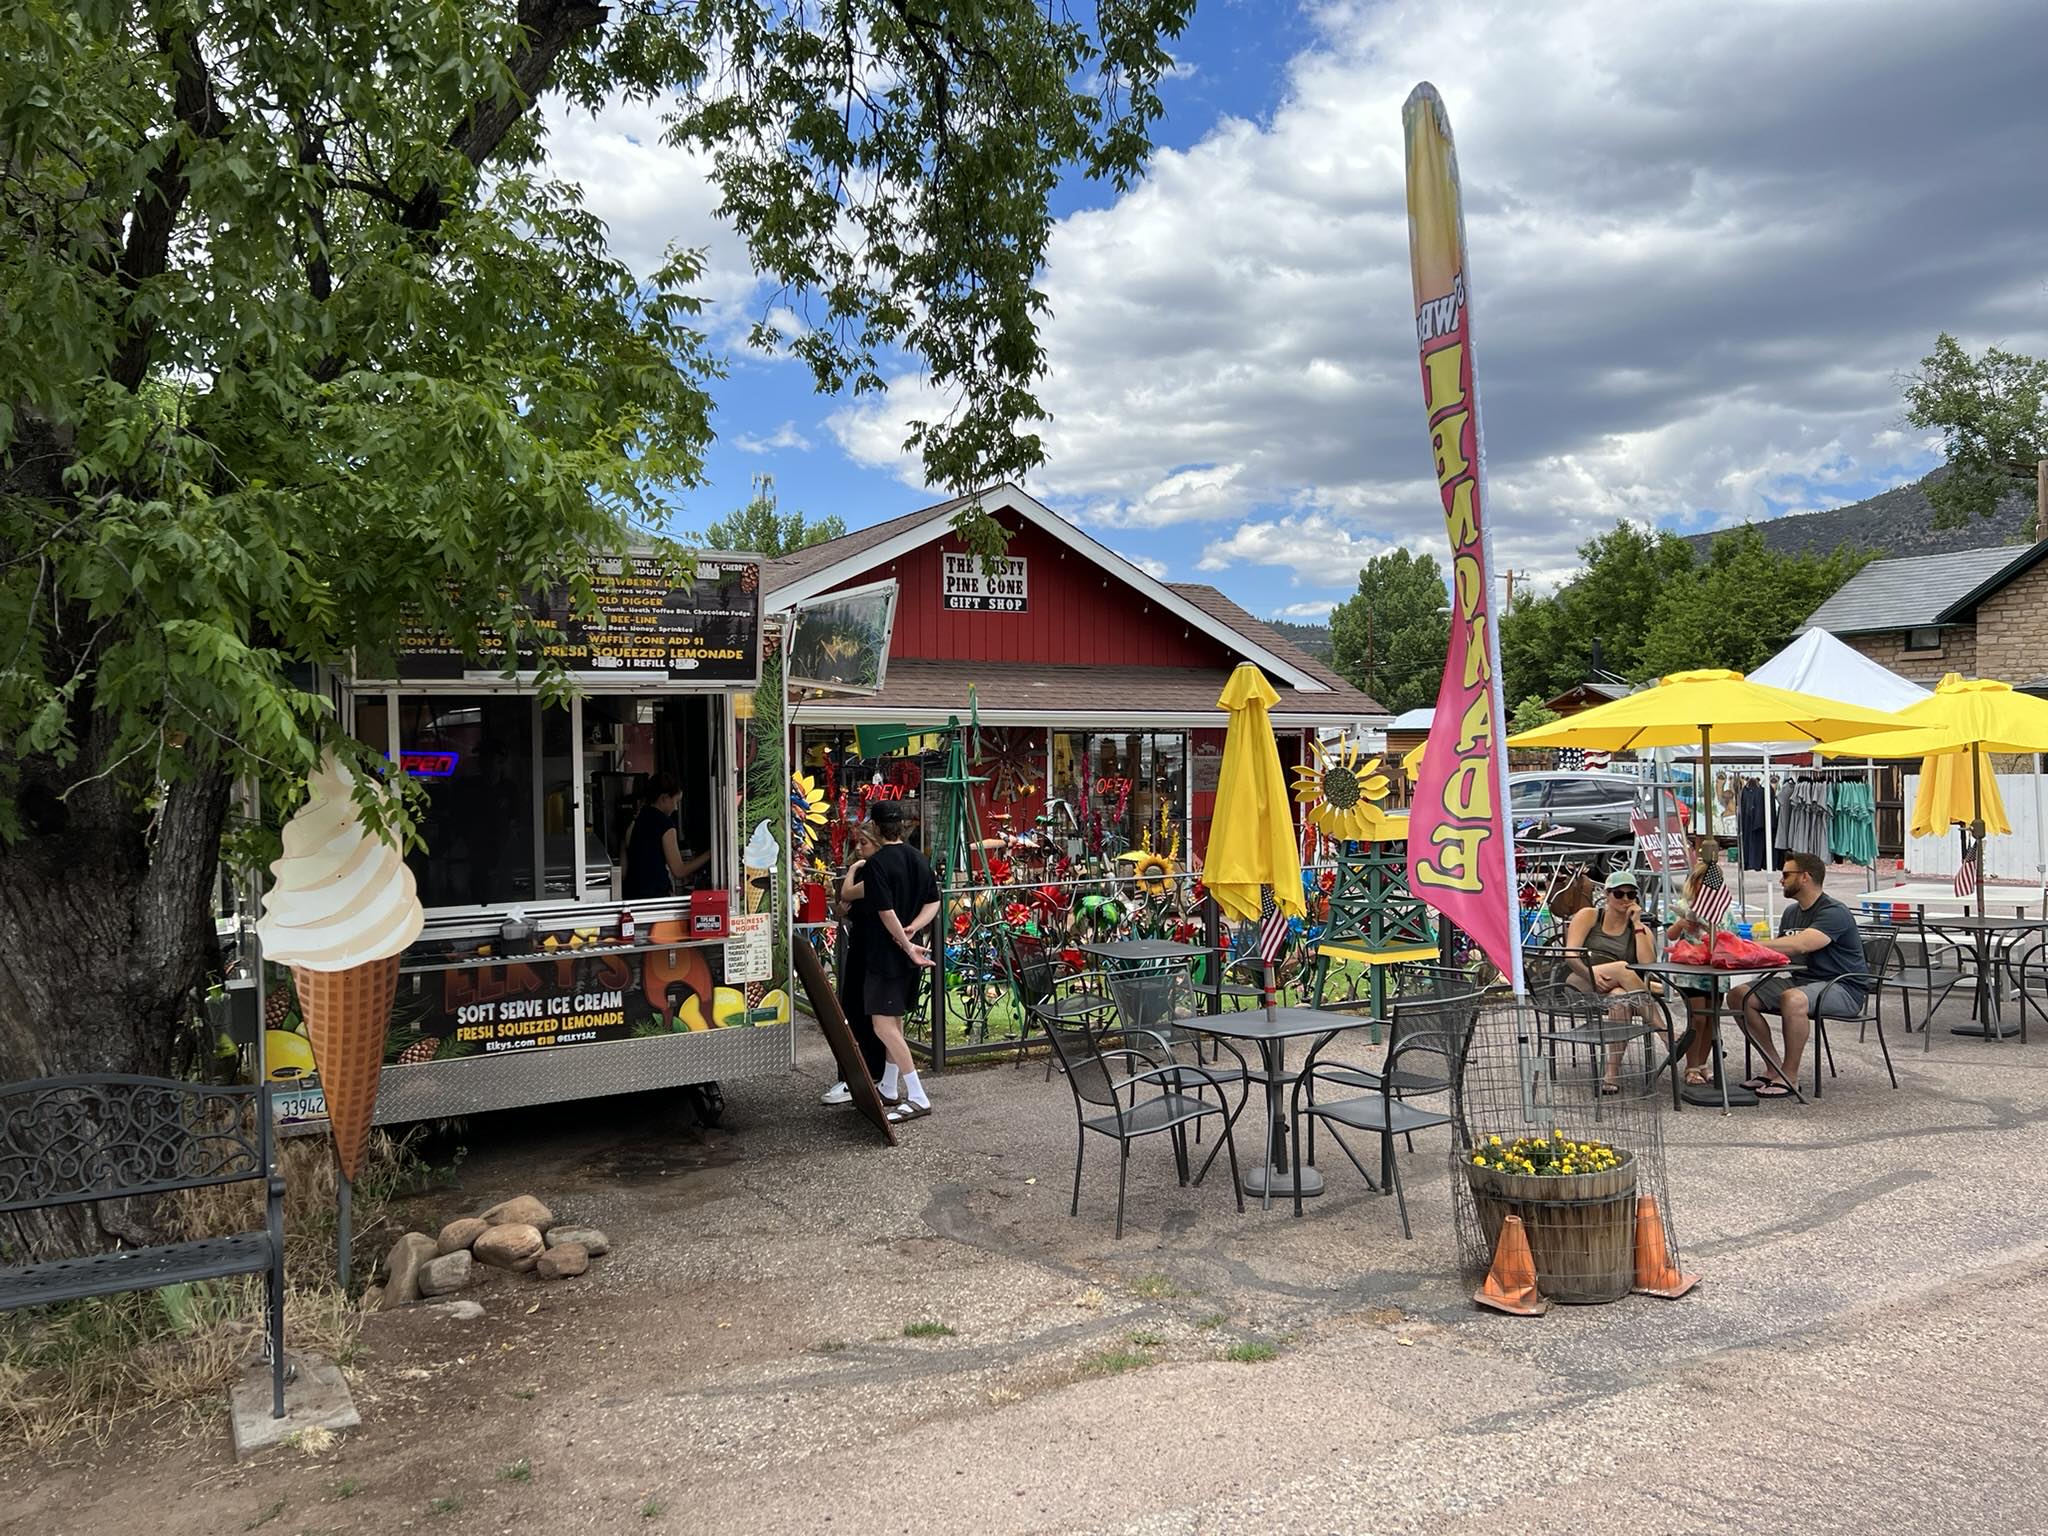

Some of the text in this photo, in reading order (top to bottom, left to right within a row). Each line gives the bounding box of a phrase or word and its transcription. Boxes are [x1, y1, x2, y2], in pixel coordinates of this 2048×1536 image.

[946, 556, 1024, 576] THE USTY
[946, 576, 1023, 595] PINE CONE
[597, 596, 618, 604] OLD
[622, 597, 663, 606] DIGGER
[950, 597, 1022, 610] GIFT SHOP
[610, 615, 657, 624] BEE-LINE
[588, 635, 704, 645] WAFFLE CONE ADD $1
[592, 647, 666, 658] SQUEEZED
[670, 648, 744, 660] LEMONADE
[633, 659, 666, 667] REFILL
[457, 991, 622, 1024] SOFT SERVE ICE CREAM
[456, 1011, 625, 1041] FRESH SQUEEZED LEMONADE
[486, 1031, 597, 1051] Elkys.com @ELKYSAZ
